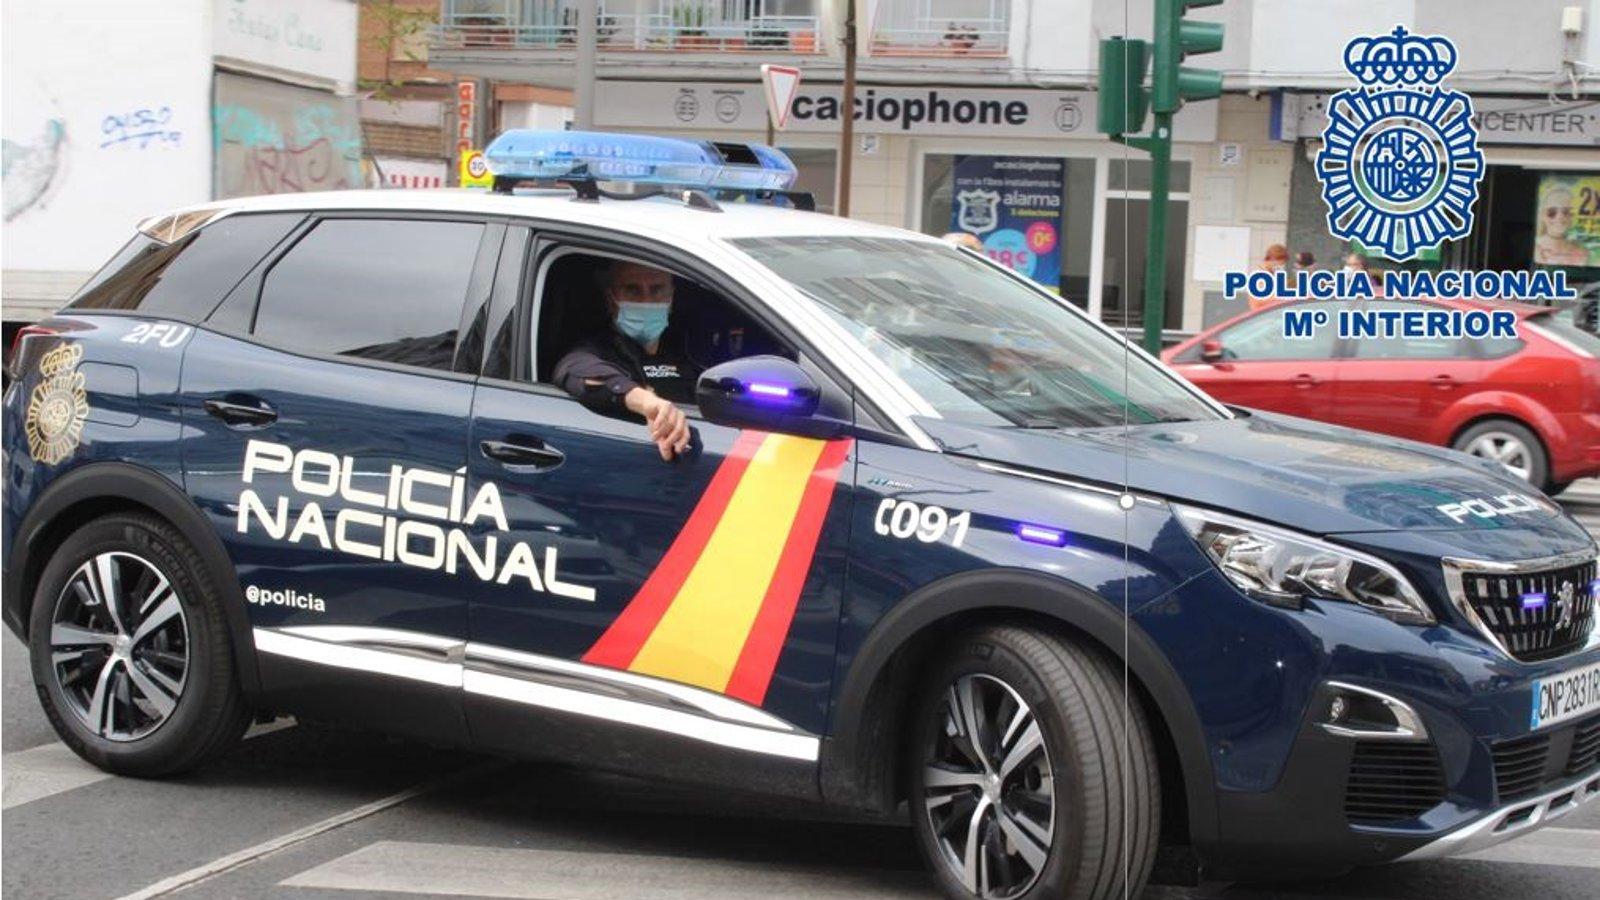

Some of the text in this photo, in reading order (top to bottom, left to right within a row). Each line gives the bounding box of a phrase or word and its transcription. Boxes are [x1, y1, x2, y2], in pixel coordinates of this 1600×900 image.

[791, 89, 1029, 130] caciophone
[1003, 190, 1060, 207] alarma
[121, 323, 191, 348] 2FU
[241, 438, 510, 532] POLICÍA
[236, 488, 597, 602] NACIONAL
[245, 584, 326, 612] @policia
